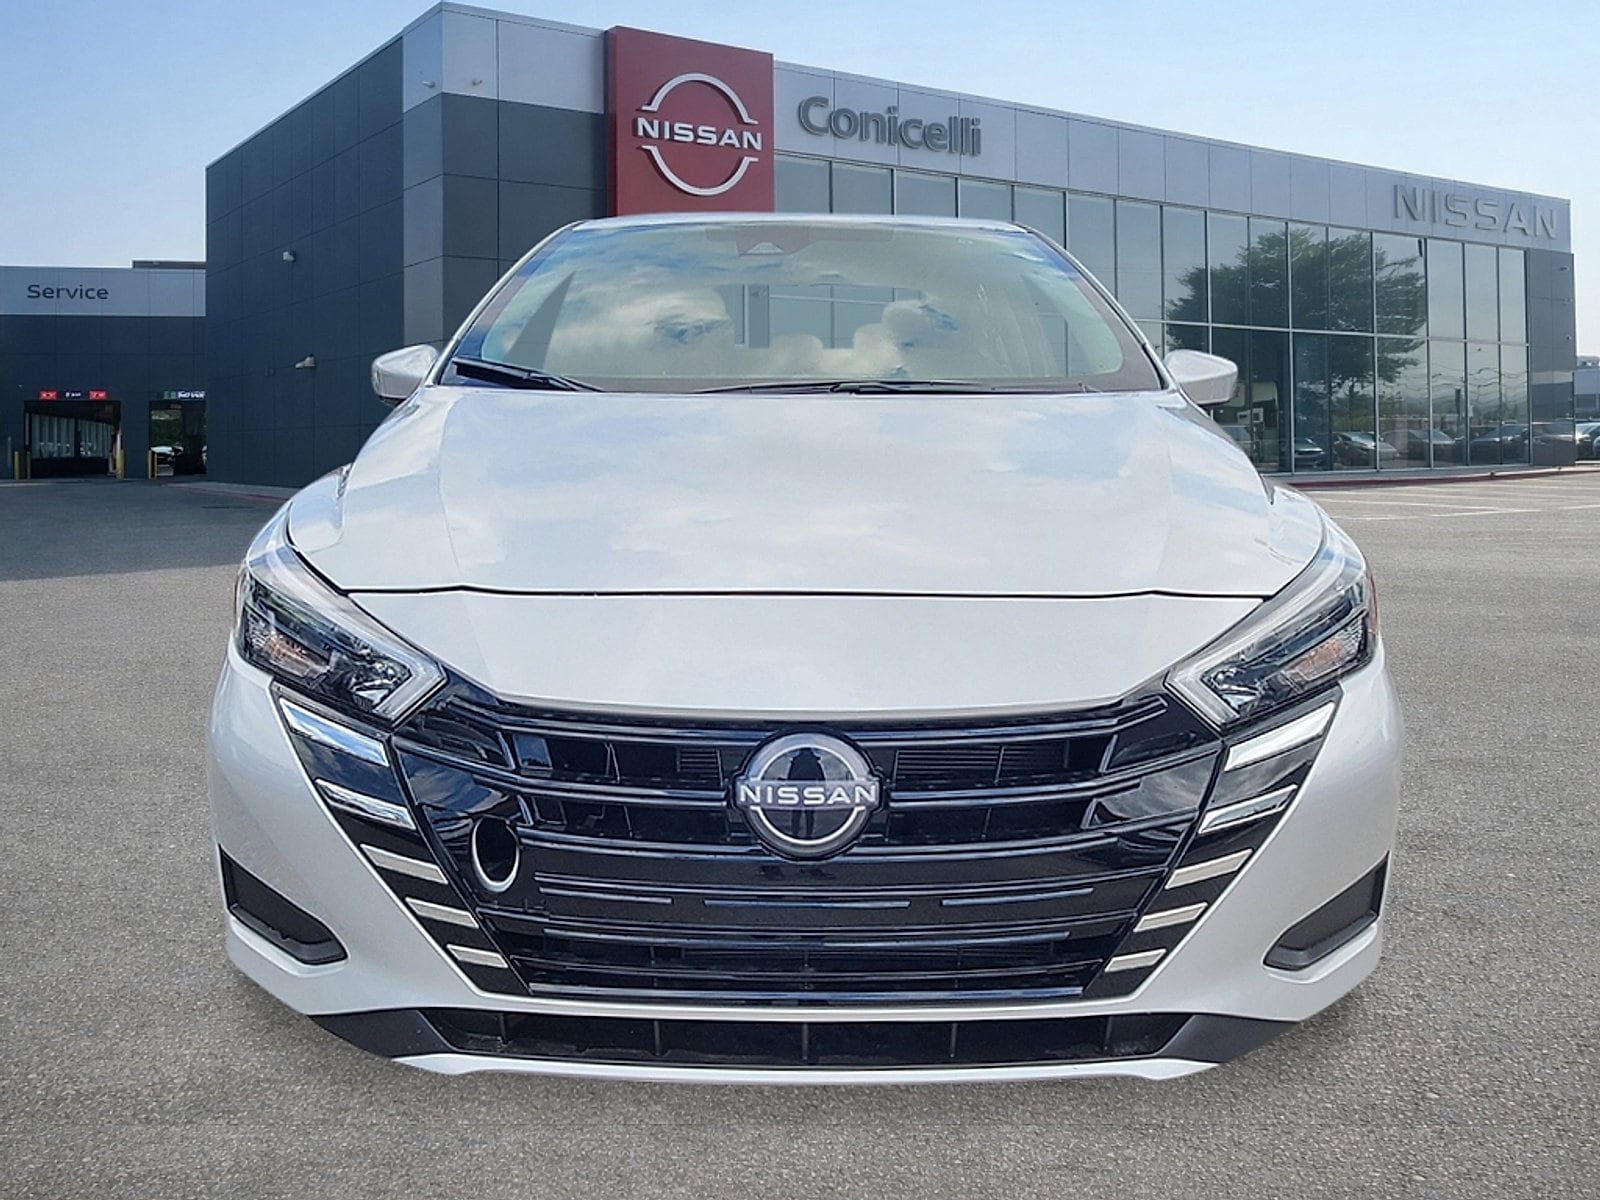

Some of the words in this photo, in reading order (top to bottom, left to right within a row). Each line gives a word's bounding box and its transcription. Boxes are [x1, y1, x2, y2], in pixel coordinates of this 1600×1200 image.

[636, 117, 762, 151] NISSAN
[798, 96, 981, 156] Conicelli
[1394, 184, 1558, 239] NISSAN
[27, 284, 109, 299] Service
[740, 785, 876, 805] NISSAN
